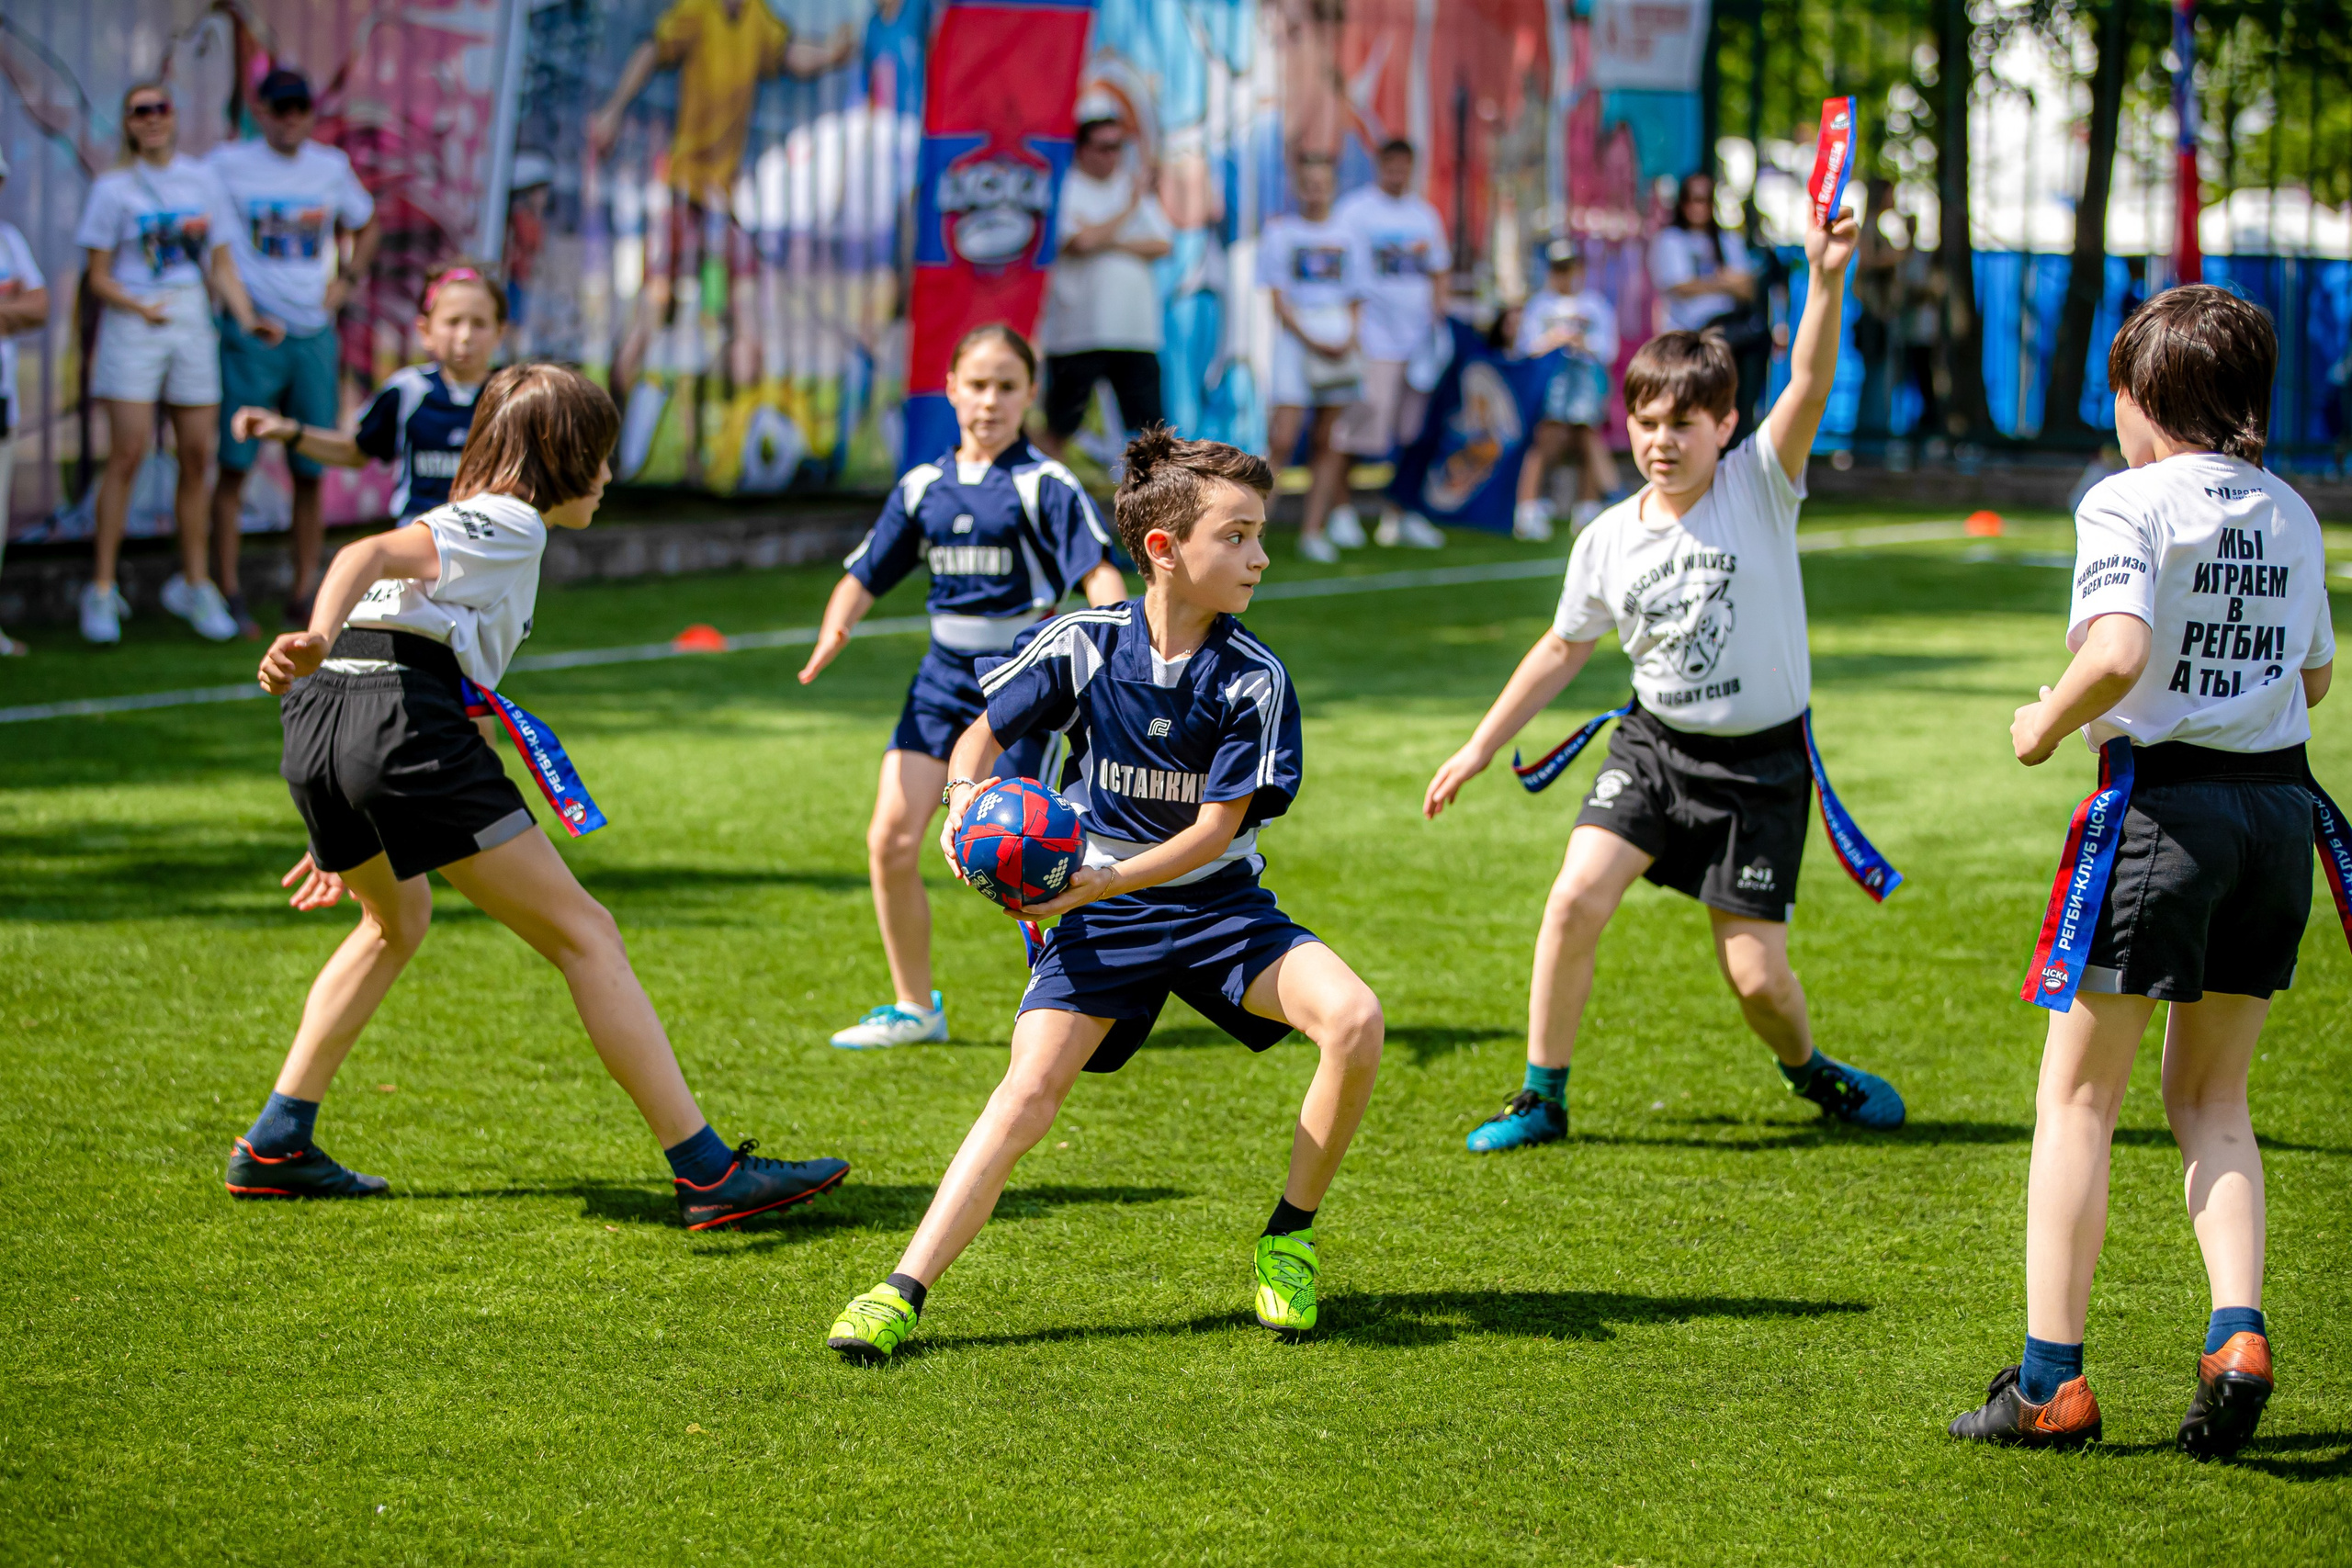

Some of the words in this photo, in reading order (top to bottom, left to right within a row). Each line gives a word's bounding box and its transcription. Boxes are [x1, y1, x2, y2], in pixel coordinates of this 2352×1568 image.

[2232, 488, 2263, 496] SPORT
[2217, 527, 2263, 560] МЫ
[1623, 559, 1675, 616] MOSCOW
[2076, 554, 2120, 588] КАЖДЫЙ
[2121, 556, 2146, 573] ИЗО
[2082, 576, 2102, 599] ВСЕХ
[2104, 572, 2131, 586] СИЛ
[2192, 562, 2289, 598] ИГРАЕМ
[2227, 597, 2243, 623] В
[2180, 621, 2285, 660] РЕГБИ!
[1657, 689, 1702, 705] RUGBY
[1706, 678, 1741, 700] CLUB
[2168, 660, 2191, 694] А
[512, 710, 565, 794] РЕГБИ-КЛУБ
[1099, 758, 1209, 804] ОСТАНКИН
[563, 802, 585, 818] ЦСКА
[2312, 793, 2335, 834] ЦСК
[2059, 841, 2098, 951] РЕГБИ-КЛУБ
[2087, 790, 2113, 838] ЦСКА
[2041, 967, 2068, 983] ЦСКА
